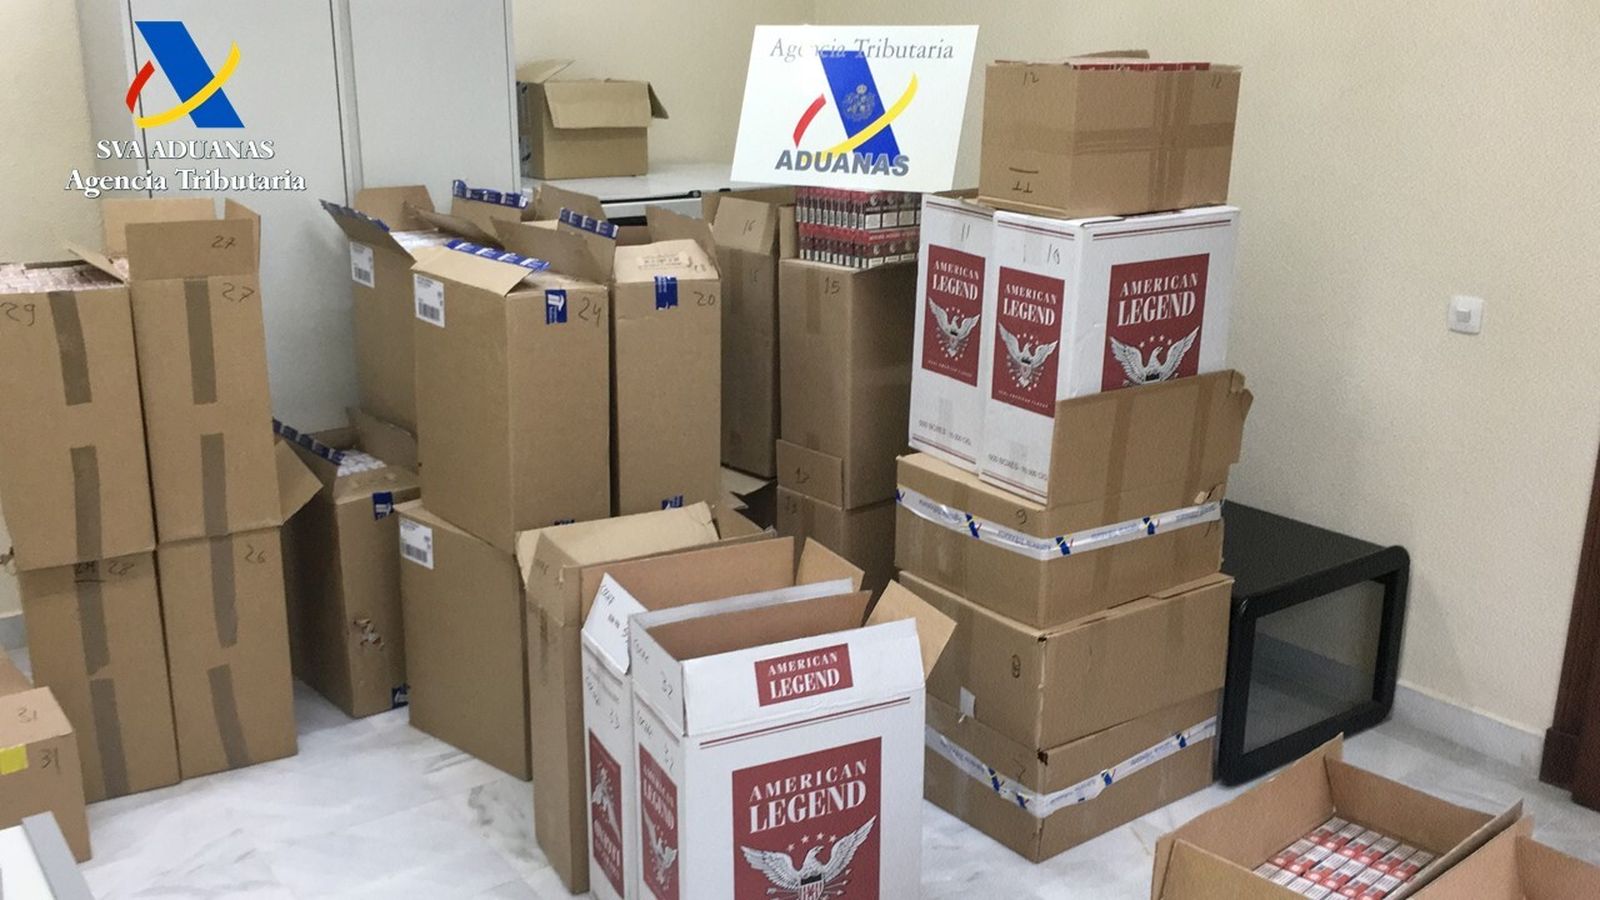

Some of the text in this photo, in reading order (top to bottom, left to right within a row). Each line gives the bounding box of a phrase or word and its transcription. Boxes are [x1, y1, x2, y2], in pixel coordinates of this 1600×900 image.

[854, 37, 954, 60] Tributaria
[774, 150, 910, 176] ADUANAS
[211, 235, 237, 249] 27
[932, 259, 980, 281] AMERICAN
[222, 283, 256, 302] 27
[823, 276, 841, 295] 15
[932, 273, 979, 301] LEGEND
[1004, 283, 1057, 305] AMERICAN
[1120, 272, 1199, 298] AMERICAN
[692, 290, 717, 307] 20
[1117, 290, 1197, 328] LEGEND
[1, 301, 36, 327] 29
[577, 296, 603, 328] 24
[1003, 297, 1056, 327] LEGEND
[1015, 509, 1028, 525] 9
[244, 544, 267, 565] 26
[767, 651, 839, 677] AMERICAN
[769, 668, 841, 700] LEGEND
[40, 746, 60, 774] 31
[750, 759, 869, 803] AMERICAN
[749, 779, 867, 834] LEGEND
